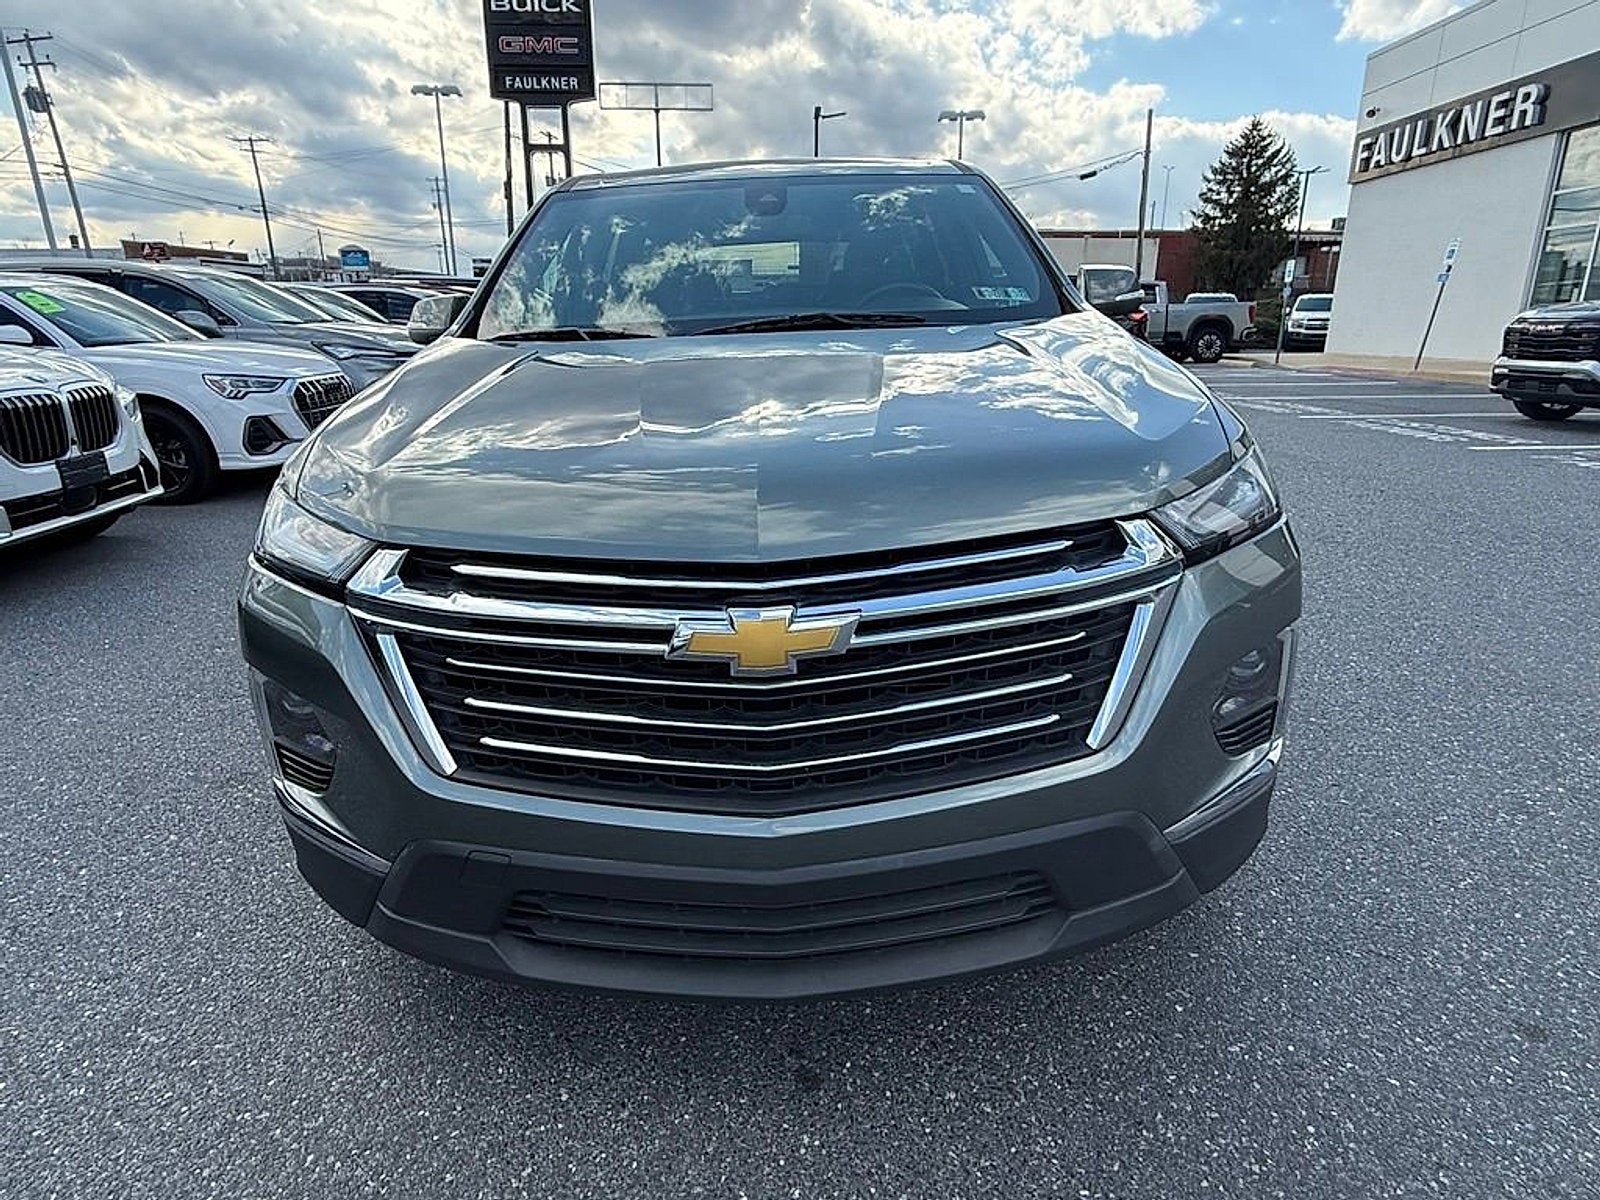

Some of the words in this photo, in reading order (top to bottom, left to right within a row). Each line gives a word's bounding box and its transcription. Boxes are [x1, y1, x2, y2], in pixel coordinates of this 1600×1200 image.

[490, 0, 581, 12] BUICK
[499, 36, 579, 54] GMC
[505, 76, 579, 90] FAULKNER
[1355, 83, 1542, 173] FAULKNER
